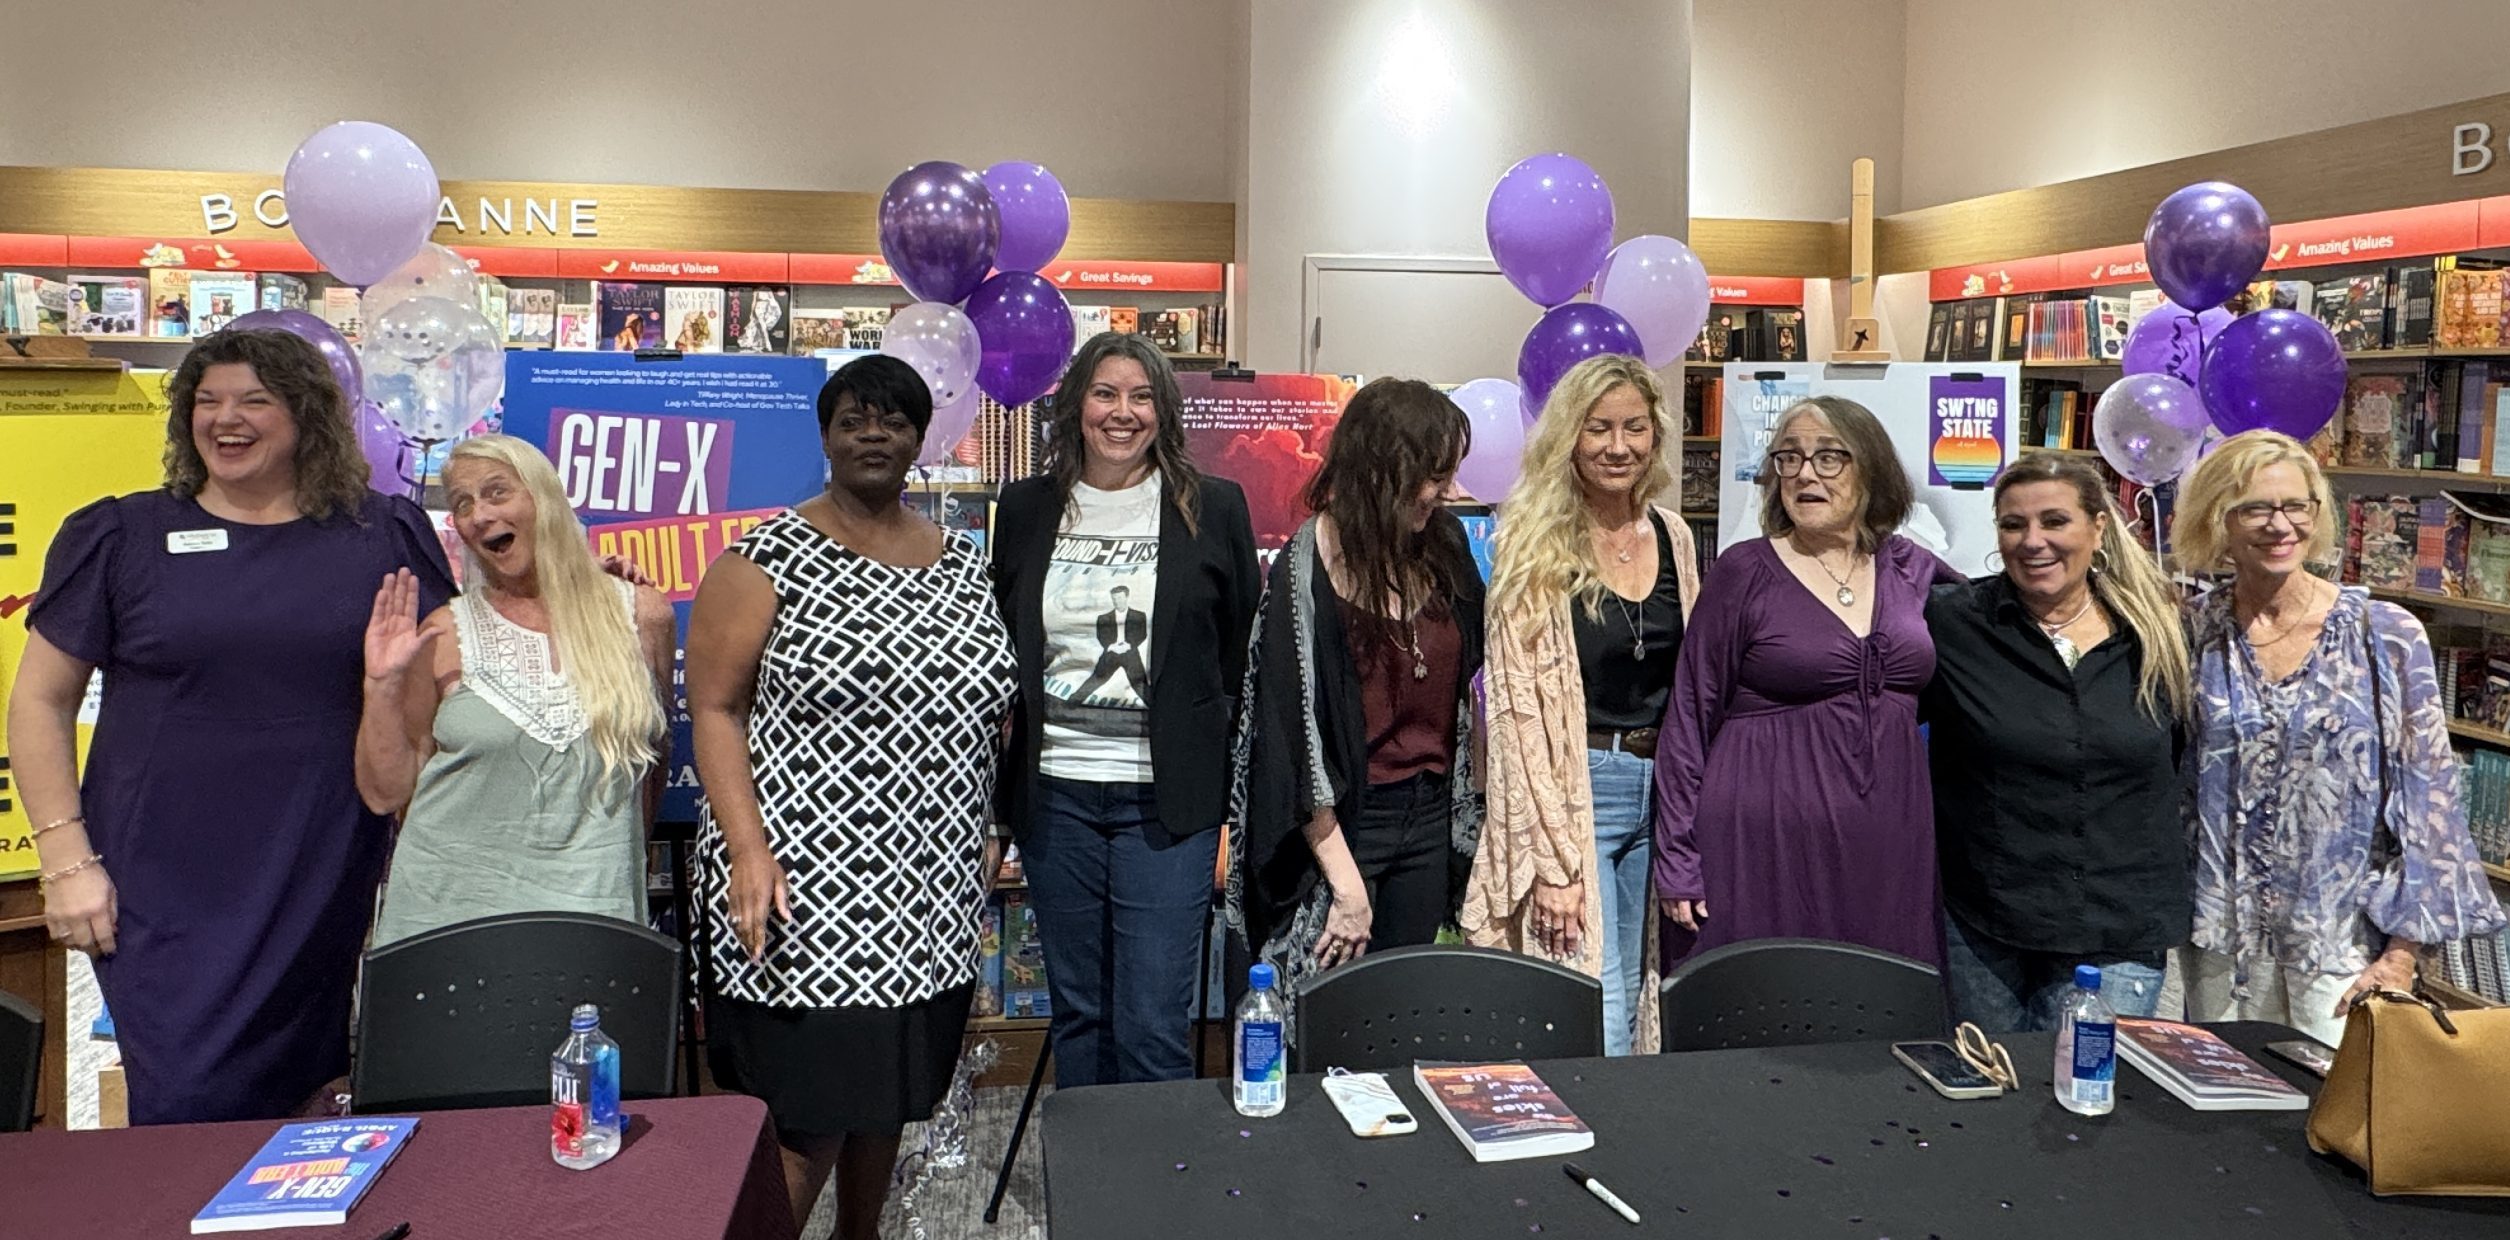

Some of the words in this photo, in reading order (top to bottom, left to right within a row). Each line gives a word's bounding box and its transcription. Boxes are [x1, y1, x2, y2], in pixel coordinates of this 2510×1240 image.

[2297, 240, 2350, 256] Amazing
[2352, 235, 2393, 251] Values
[628, 261, 680, 275] Amazing
[681, 262, 719, 274] Values
[2109, 262, 2133, 276] Great
[1080, 271, 1110, 282] Great
[1112, 271, 1153, 285] Savings
[606, 288, 659, 299] TAYLOR
[668, 291, 716, 300] TAYLOR
[1716, 287, 1747, 297] Values
[612, 298, 653, 306] SWIFT
[668, 300, 715, 310] SWIFT
[64, 401, 116, 413] Swinging
[118, 401, 144, 411] with
[1236, 398, 1267, 408] happen
[1270, 398, 1292, 406] when
[1937, 397, 1998, 418] SWING
[1192, 421, 1212, 430] Lost
[1214, 421, 1250, 430] Flowers
[1253, 421, 1264, 430] of
[1292, 422, 1313, 431] Hart
[1942, 418, 1993, 439] STATE
[556, 412, 718, 515] GEN-X
[1508, 1084, 1539, 1094] full
[1493, 1093, 1519, 1101] are
[1492, 1102, 1545, 1114] skies
[266, 1175, 353, 1200] GEN-X
